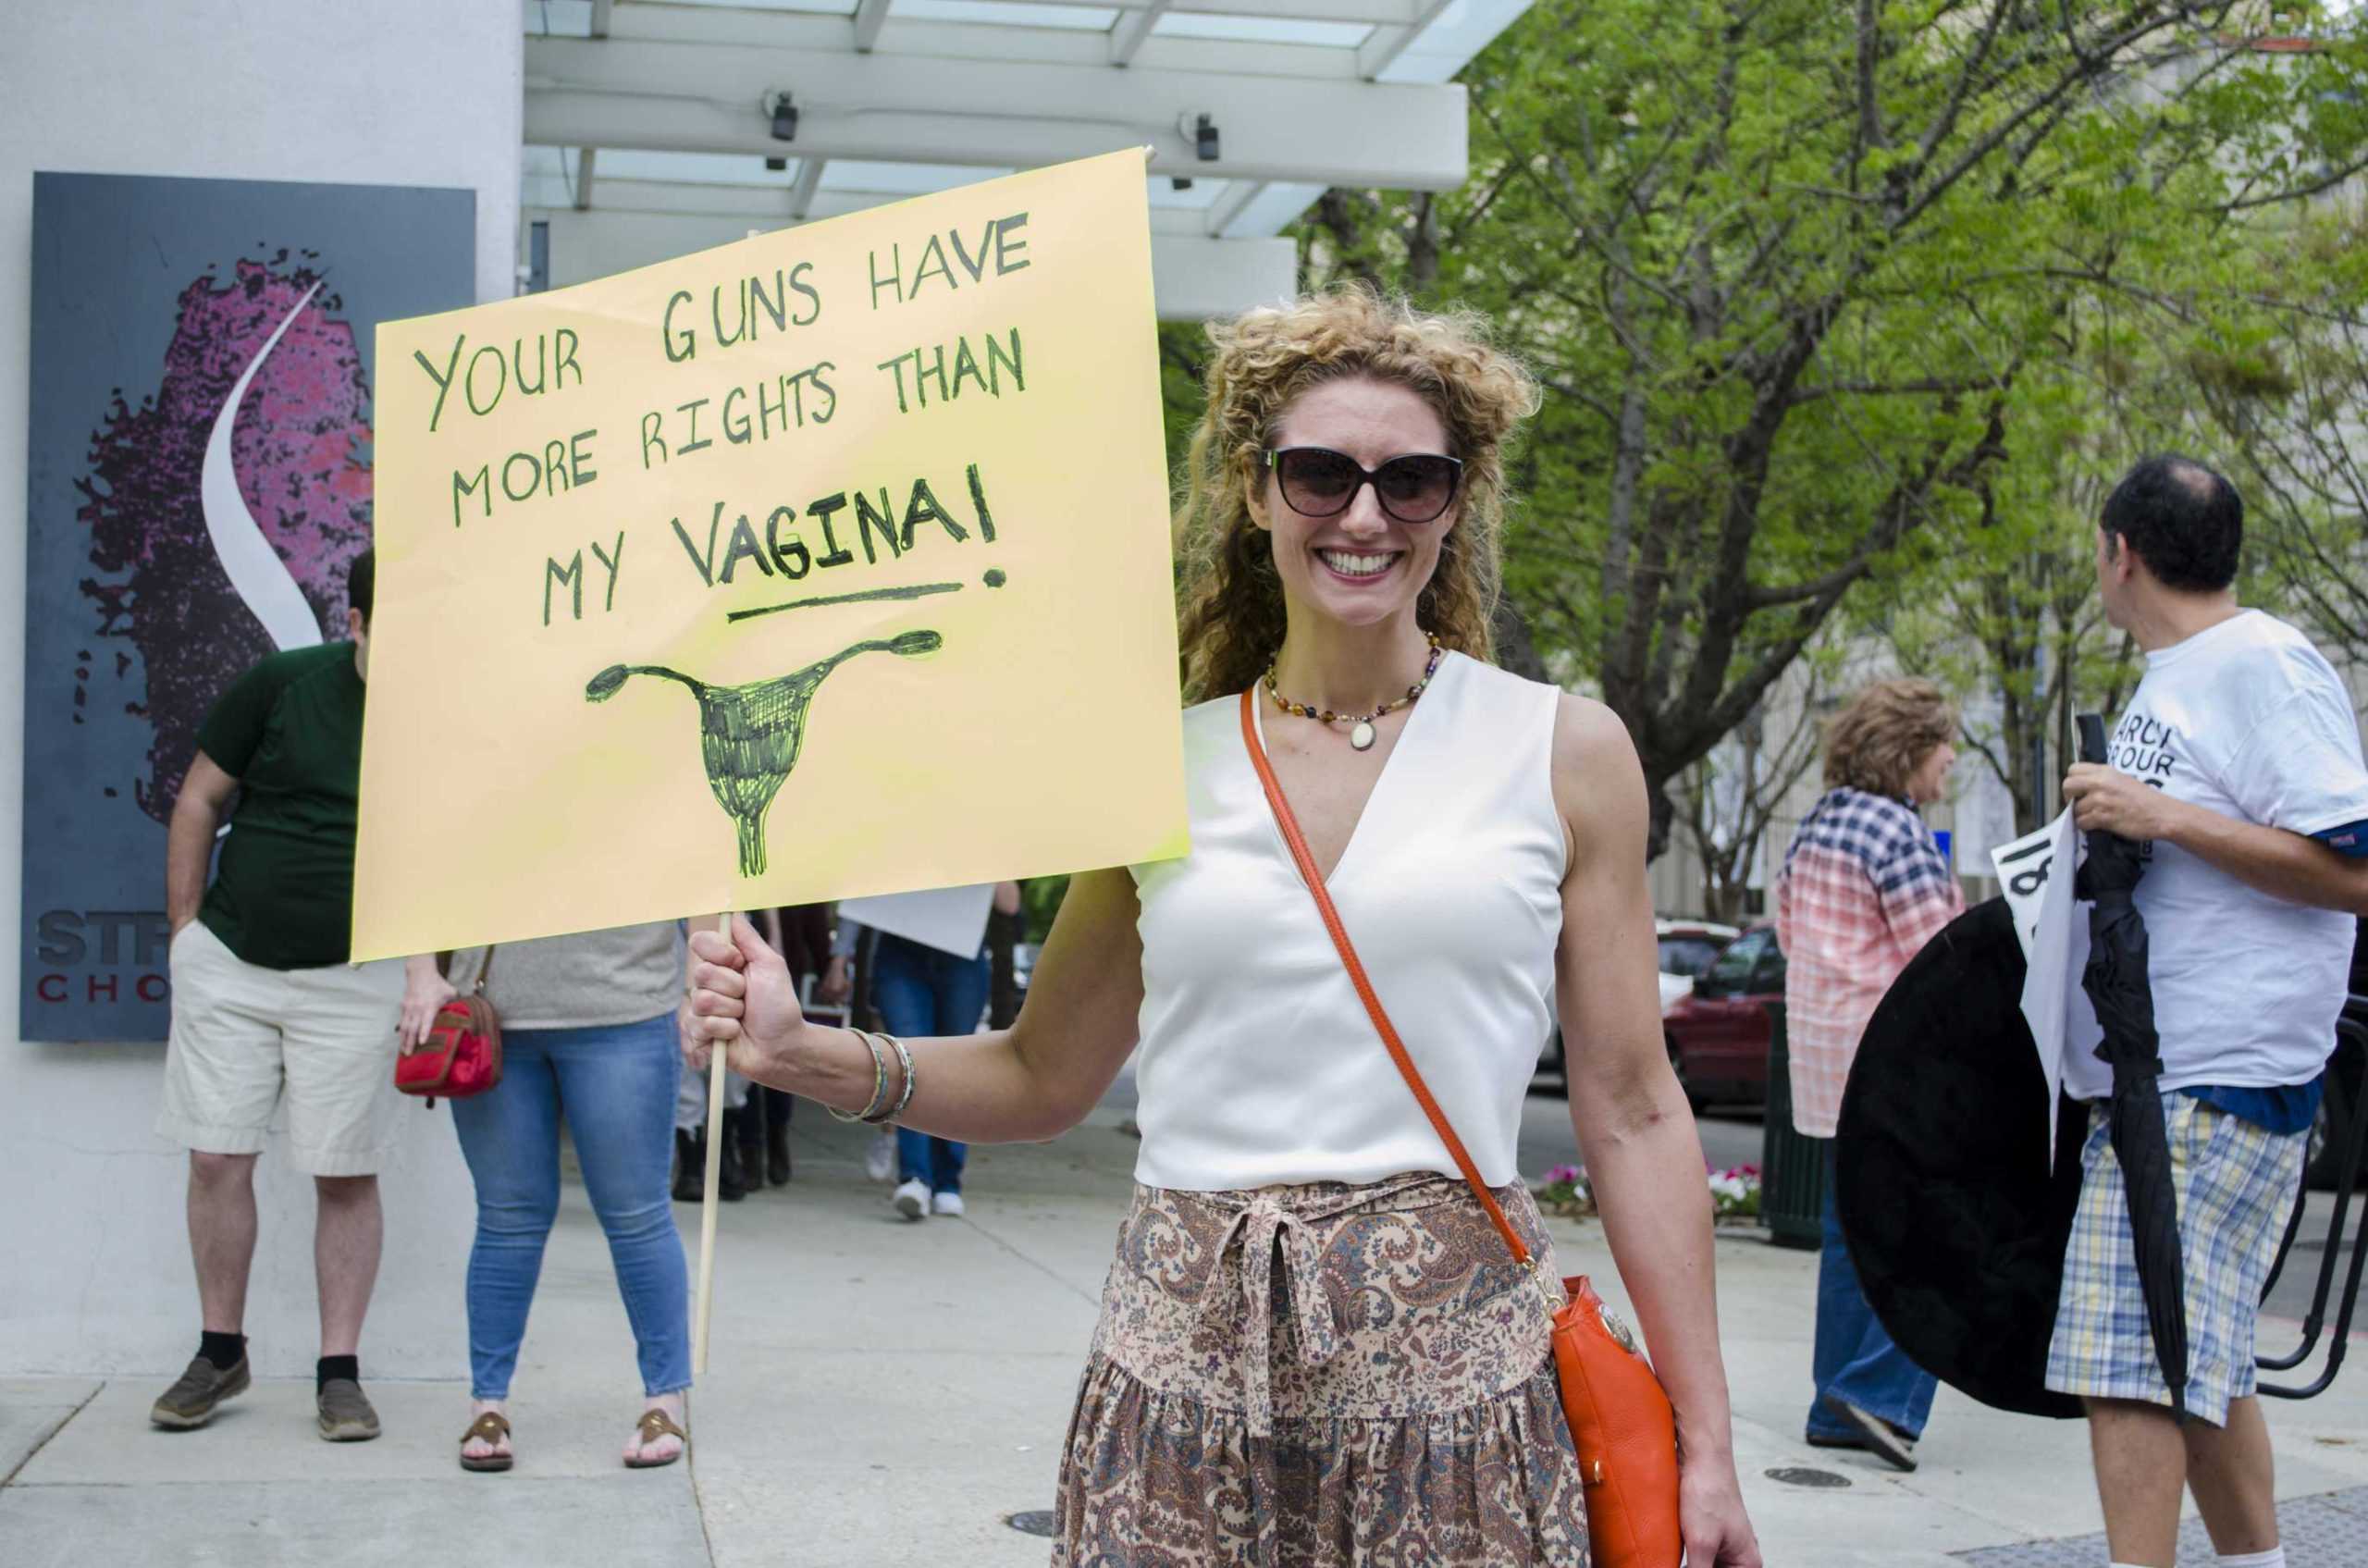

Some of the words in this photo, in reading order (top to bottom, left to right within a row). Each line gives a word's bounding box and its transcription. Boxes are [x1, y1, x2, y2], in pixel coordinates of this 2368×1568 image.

[414, 329, 581, 432] YOUR
[663, 263, 820, 363] GUNS
[870, 213, 1030, 309] HAVE
[453, 429, 597, 527] MORE
[643, 362, 835, 469] RIGHTS
[878, 327, 1025, 414] THAN
[544, 531, 623, 626] MY
[672, 465, 1006, 587] VAGINA!
[2120, 747, 2175, 776] OUR
